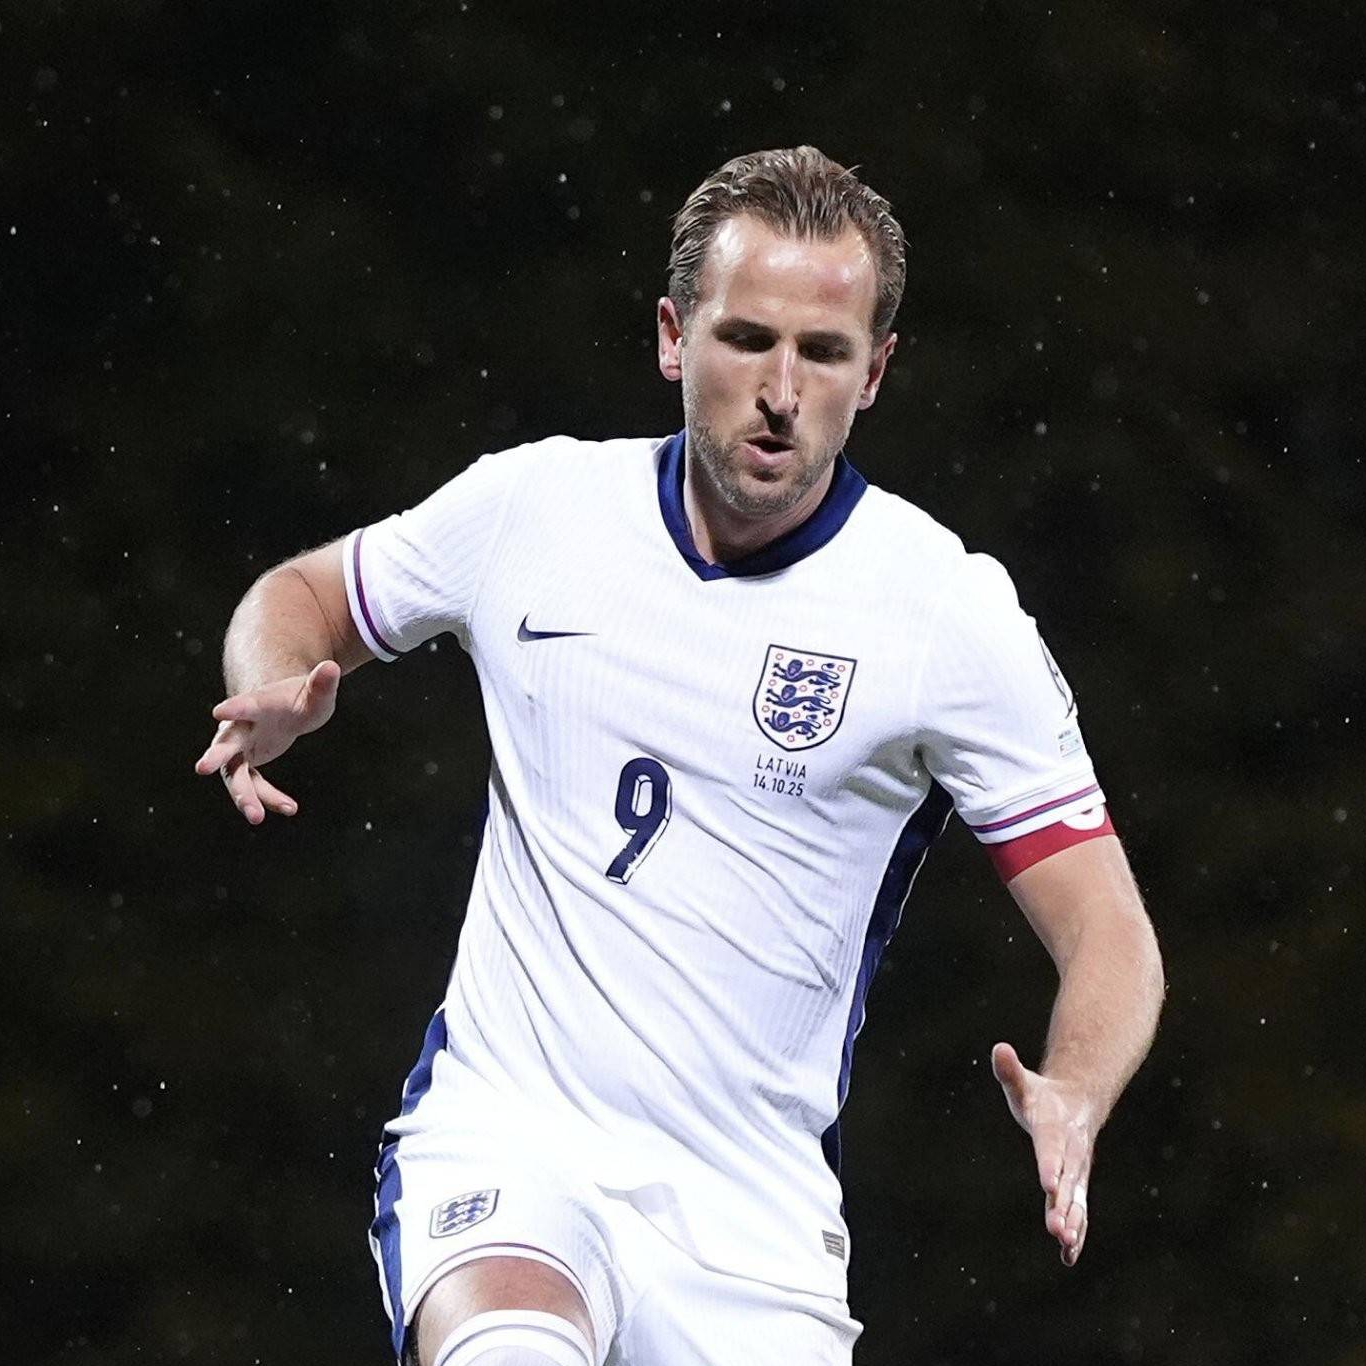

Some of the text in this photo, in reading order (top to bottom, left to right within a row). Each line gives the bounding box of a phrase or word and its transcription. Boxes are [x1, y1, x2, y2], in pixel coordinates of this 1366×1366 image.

[756, 754, 806, 778] LATVIA
[753, 773, 805, 797] 14.10.25
[605, 757, 673, 886] 9
